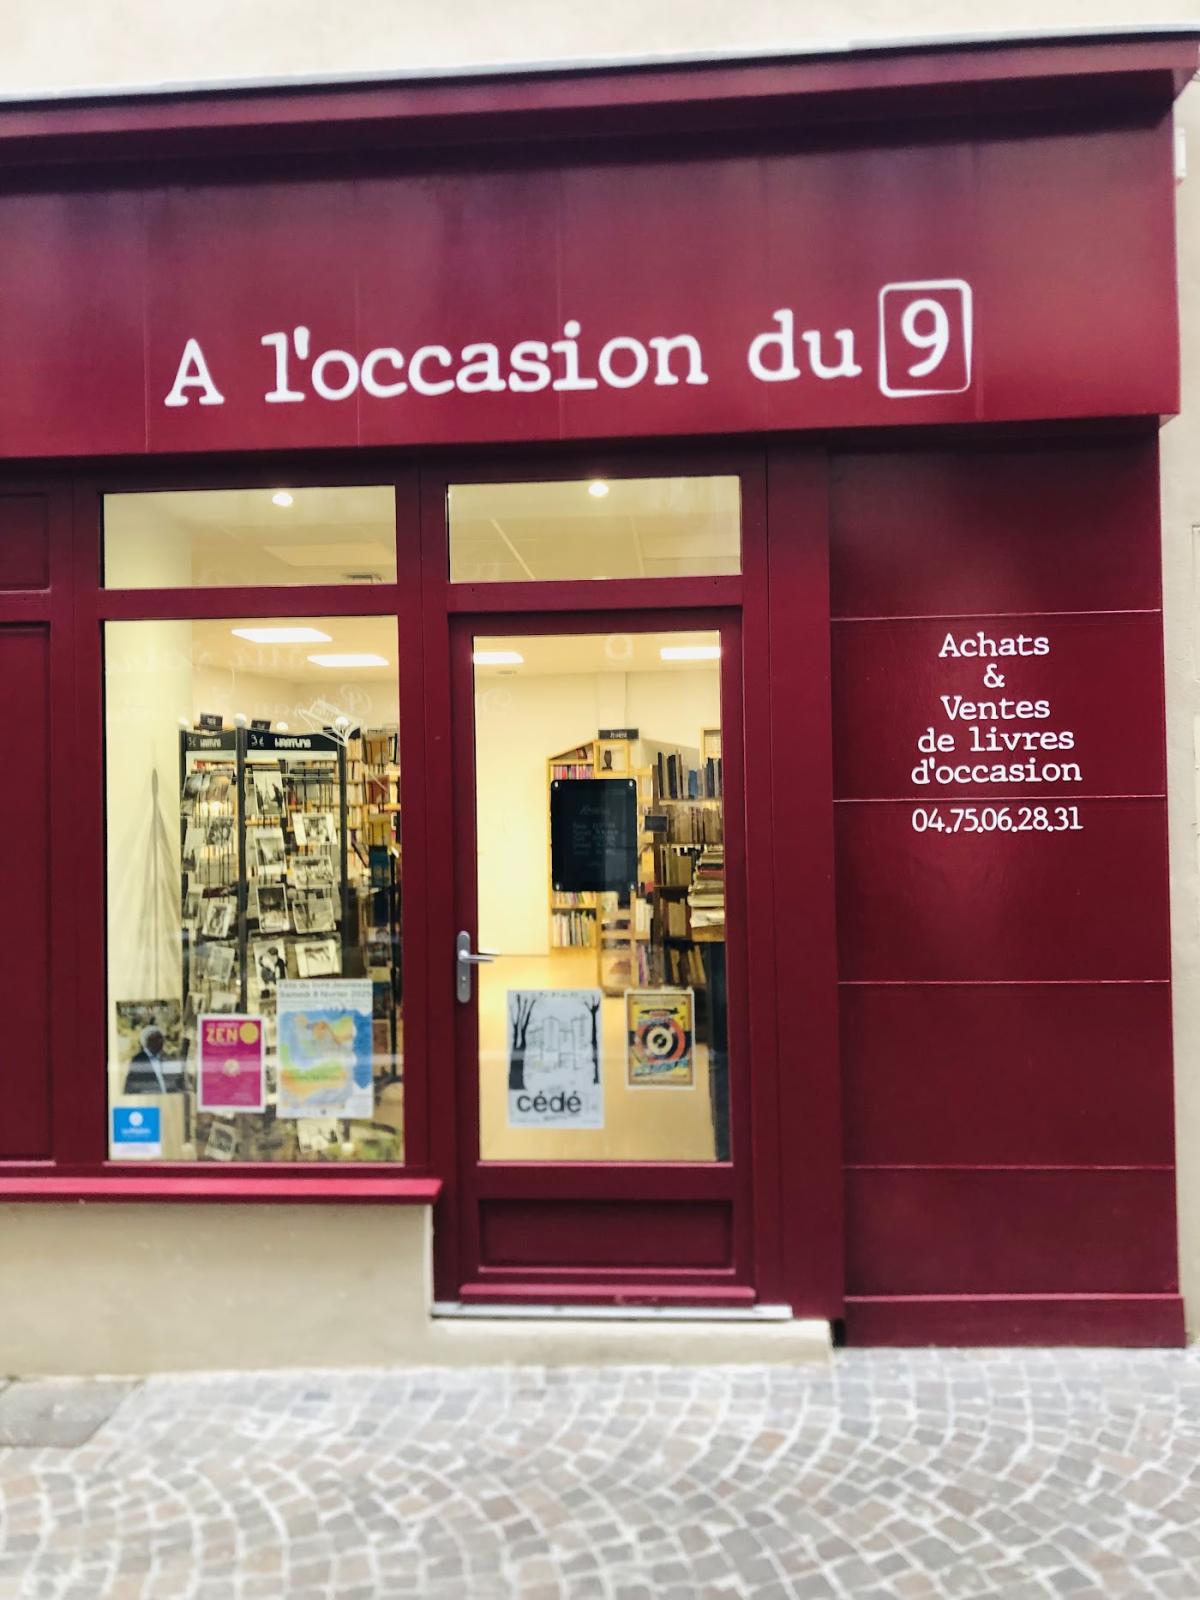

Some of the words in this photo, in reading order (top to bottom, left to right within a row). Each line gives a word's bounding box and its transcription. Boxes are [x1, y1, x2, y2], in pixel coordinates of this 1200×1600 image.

[164, 338, 225, 407] A
[260, 320, 709, 404] l'occasion
[747, 308, 863, 382] du
[901, 298, 950, 377] 9
[938, 631, 1050, 658] Achats
[983, 663, 1006, 689] &
[940, 694, 1051, 721] Ventes
[917, 727, 956, 753] de
[969, 726, 1075, 752] livres
[911, 757, 1083, 785] d'occasion
[911, 806, 1084, 834] 04.75.06.28.31
[206, 1027, 238, 1043] ZEN
[516, 1090, 581, 1113] cédé
